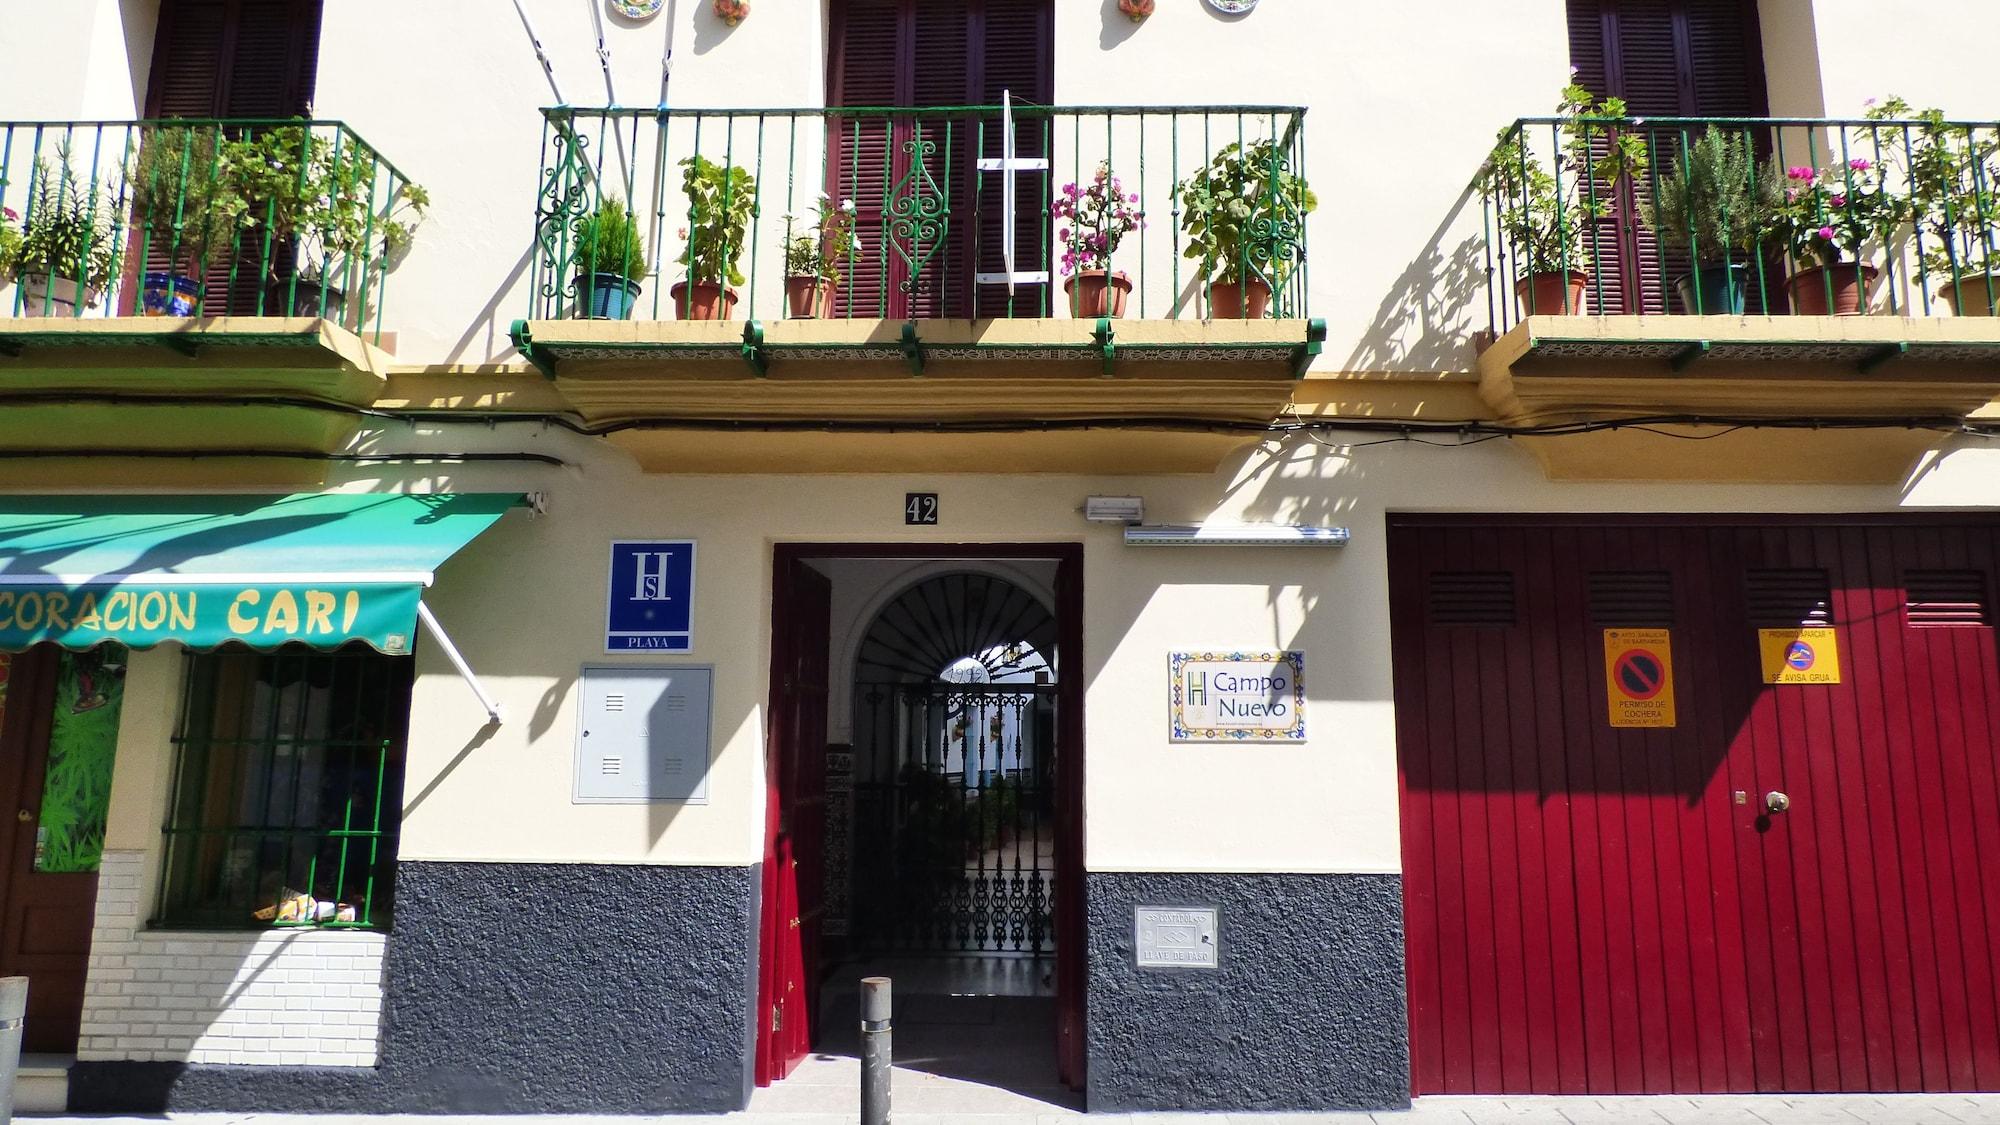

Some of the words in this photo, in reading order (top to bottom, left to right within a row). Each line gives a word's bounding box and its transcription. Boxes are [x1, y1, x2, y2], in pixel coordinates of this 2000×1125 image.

[907, 496, 937, 522] 42
[0, 590, 197, 631] CORACION
[227, 590, 360, 635] CARI
[627, 637, 669, 649] PLAYA
[1771, 673, 1782, 682] SE
[1785, 673, 1807, 682] AVISA
[1809, 673, 1830, 682] GRUA
[1187, 671, 1207, 706] H
[1213, 672, 1286, 695] Campo
[1219, 698, 1287, 718] Nuevo
[1619, 700, 1654, 708] PERMISO
[1655, 700, 1666, 708] DE
[1143, 951, 1170, 961] LLAVE
[1173, 952, 1184, 962] DE
[1187, 952, 1209, 962] PASO
